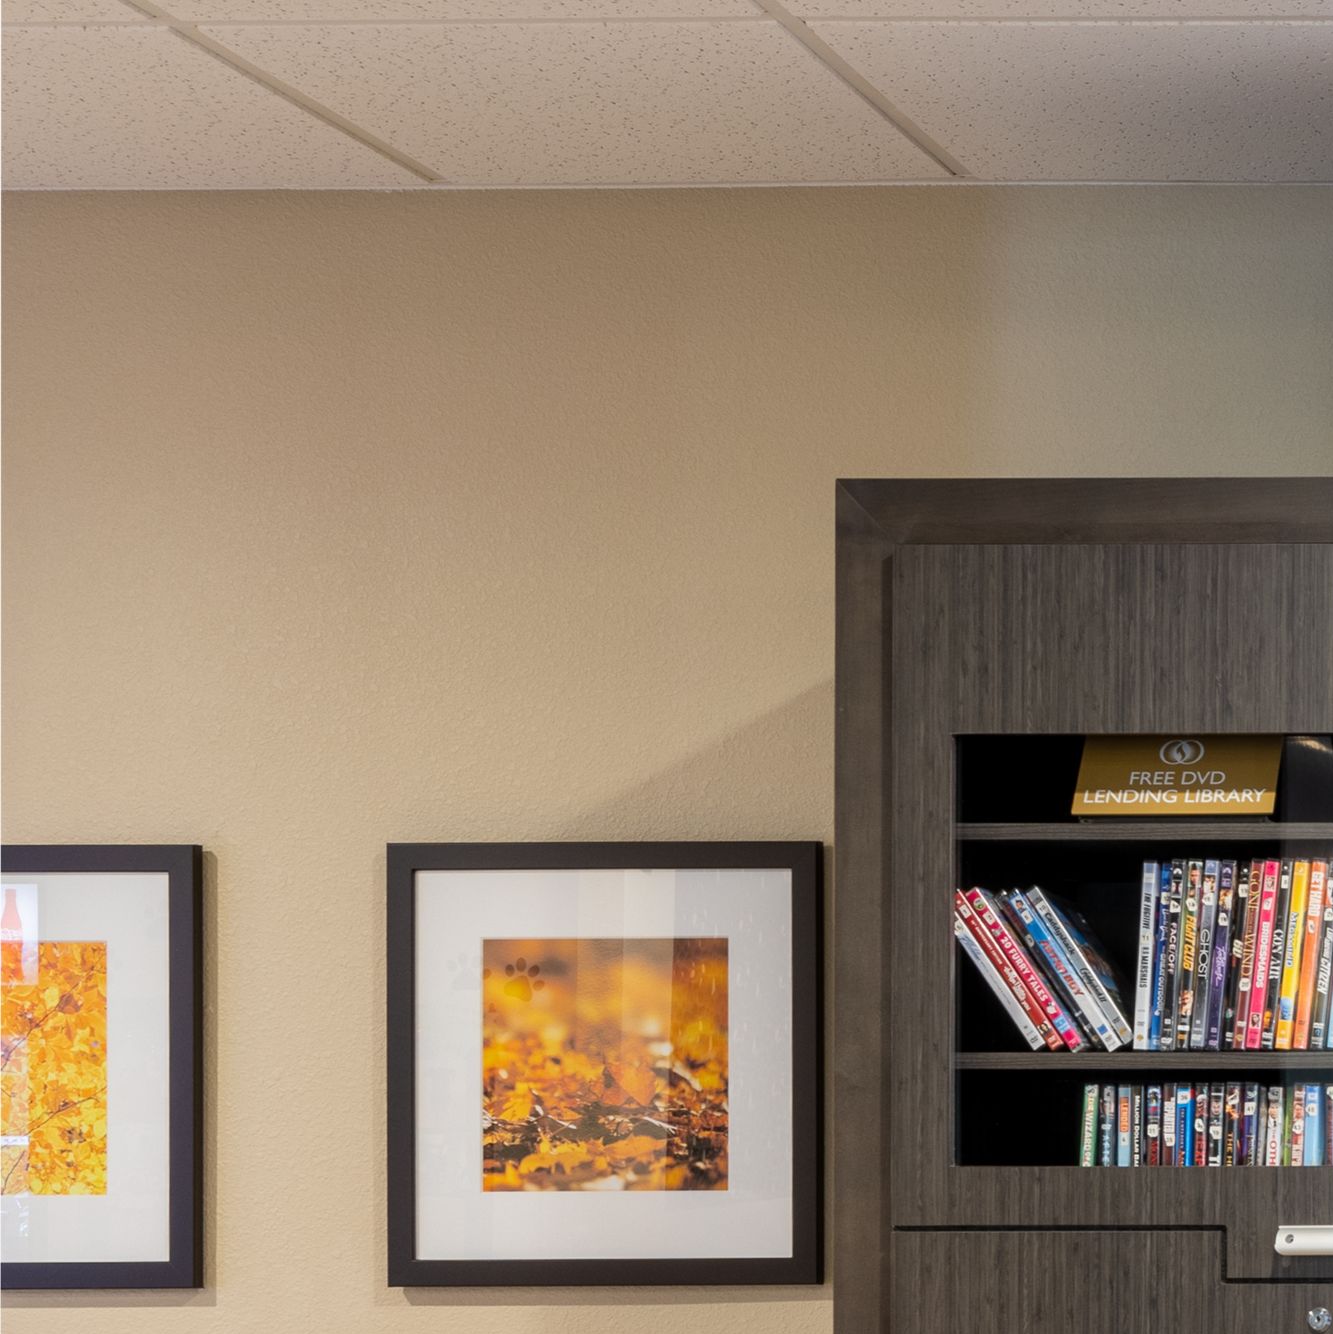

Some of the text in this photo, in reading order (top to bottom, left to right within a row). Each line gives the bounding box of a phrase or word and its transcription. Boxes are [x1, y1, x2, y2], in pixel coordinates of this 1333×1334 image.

[1084, 788, 1267, 804] LENDING LIBRARY
[1129, 771, 1226, 785] FREE DVD
[1249, 870, 1260, 911] GONE
[1309, 871, 1325, 917] GET HARD
[1168, 921, 1177, 976] FACE/OFF
[1183, 914, 1198, 971] FIGHT CLUB
[1198, 929, 1211, 979] GHOST
[1241, 933, 1256, 977] WIND
[1256, 922, 1270, 989] BRIDESMAIDS
[1268, 928, 1284, 980] CON AIR
[1008, 947, 1031, 976] FURRY
[1026, 973, 1049, 1003] TALES
[1317, 957, 1332, 995] CITIZEN
